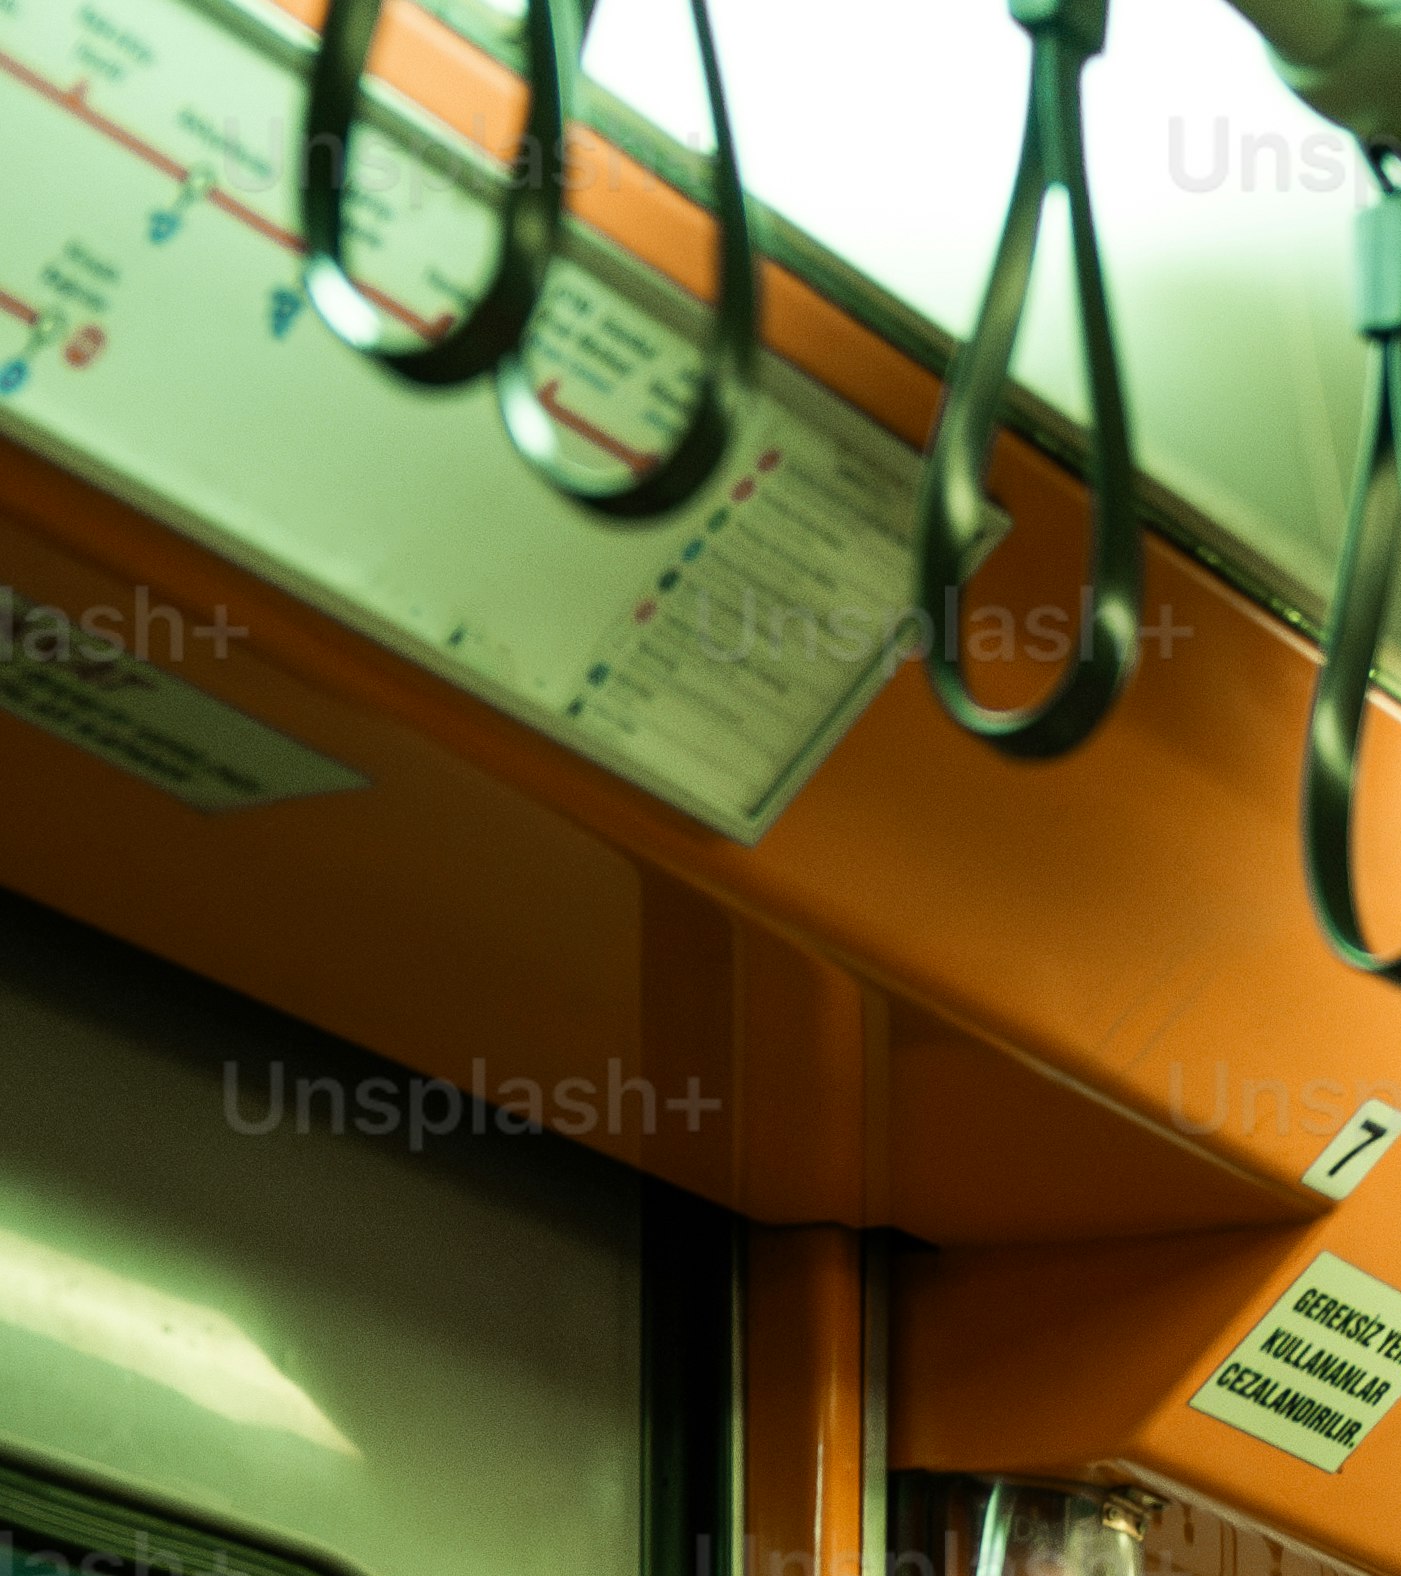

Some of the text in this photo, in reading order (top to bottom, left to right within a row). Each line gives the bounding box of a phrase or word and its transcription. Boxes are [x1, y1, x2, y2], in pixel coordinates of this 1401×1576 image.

[1327, 1119, 1387, 1178] 7
[1292, 1287, 1386, 1348] GEREKSİZ
[1259, 1326, 1391, 1407] KULLANANLAR
[1215, 1361, 1363, 1449] CEZALANDIRILIR.
